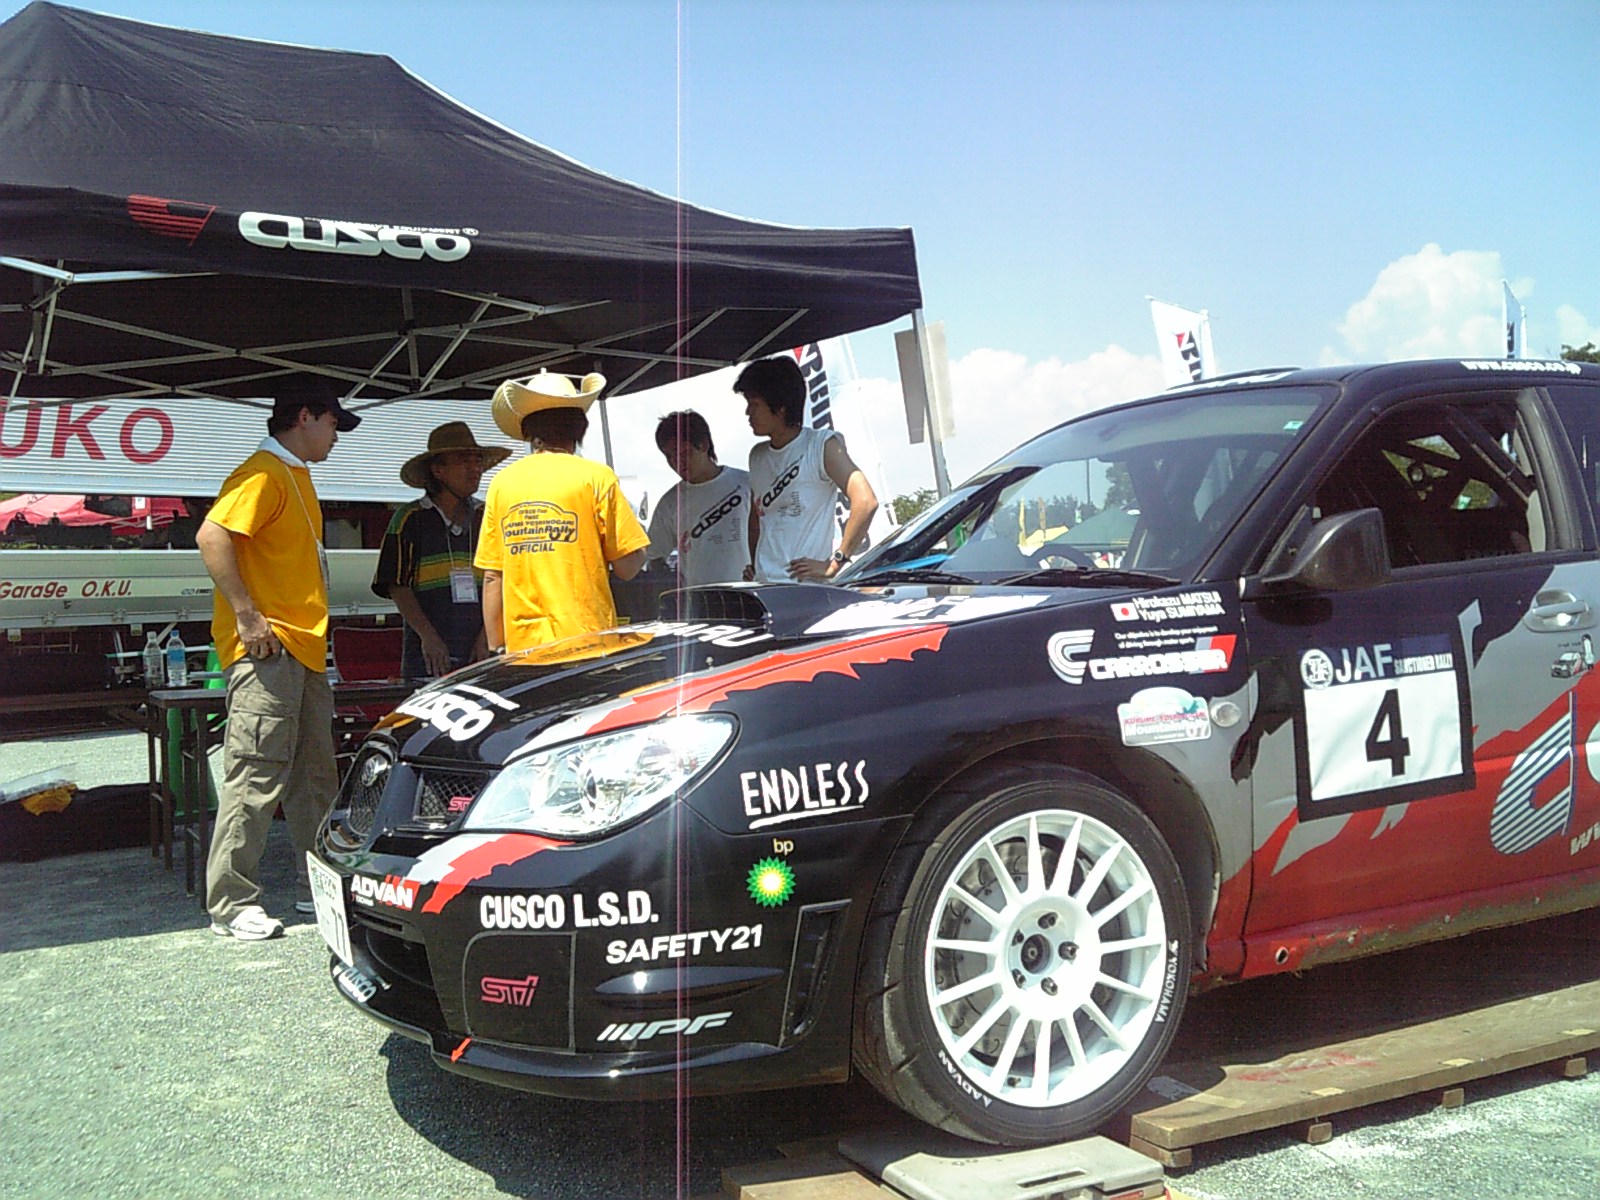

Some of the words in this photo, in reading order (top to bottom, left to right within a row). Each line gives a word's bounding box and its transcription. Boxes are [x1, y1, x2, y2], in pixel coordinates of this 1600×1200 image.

[239, 211, 471, 261] CUSCO
[762, 465, 799, 507] CUSCO
[505, 525, 576, 537] ountainRally
[691, 494, 742, 538] CUSCO
[81, 580, 132, 598] O.K.U.
[1336, 643, 1392, 682] JAF
[1365, 688, 1411, 777] 4
[740, 759, 869, 816] ENDLESS
[773, 838, 794, 856] bp
[351, 874, 413, 908] ADVAN
[480, 895, 565, 929] CUSCO
[574, 890, 659, 928] L.S.D.
[605, 924, 763, 964] SAFETY21
[1154, 956, 1178, 1023] YOKOHAMA
